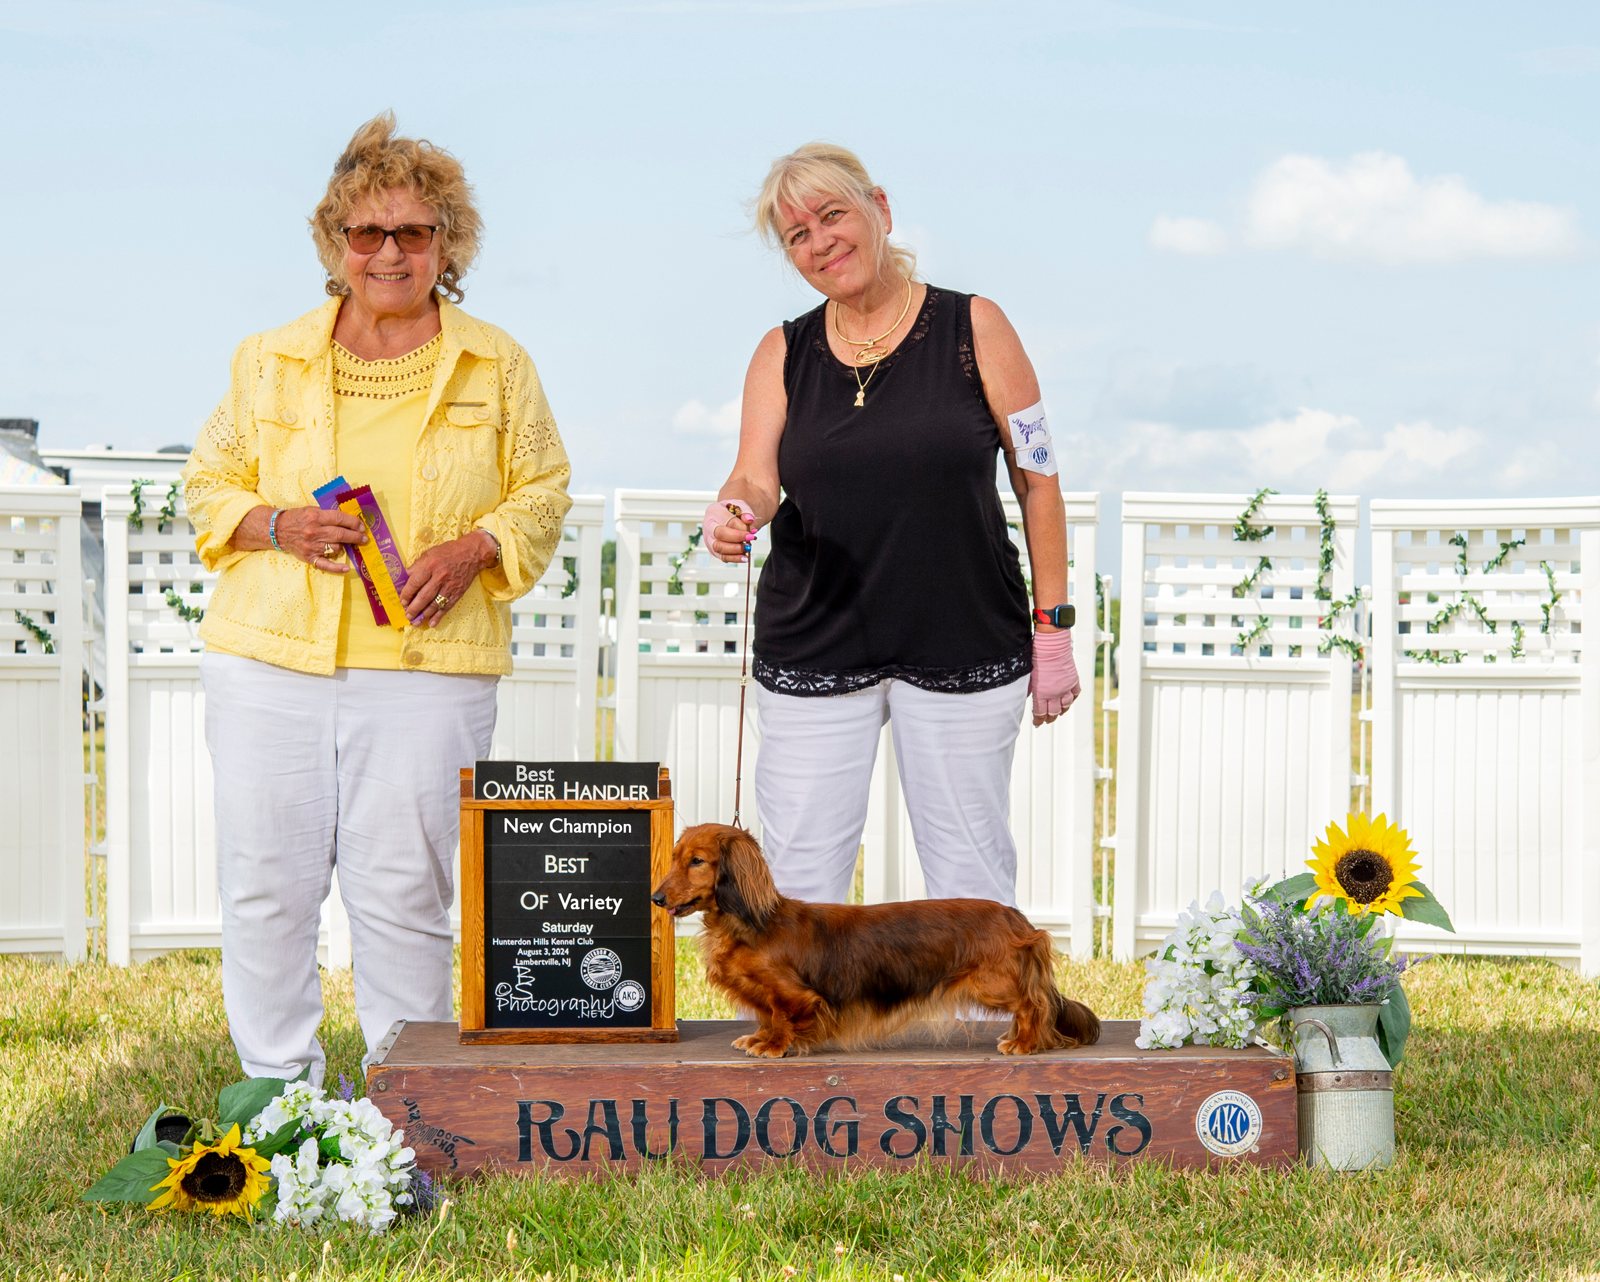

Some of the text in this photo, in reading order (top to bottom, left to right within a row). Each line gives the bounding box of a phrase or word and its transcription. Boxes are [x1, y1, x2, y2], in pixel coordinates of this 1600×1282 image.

[516, 765, 555, 782] Best
[483, 780, 650, 801] OWNER HANDLER
[503, 818, 632, 838] New Champion
[544, 855, 589, 874] BEST
[520, 891, 623, 915] OF Variety
[541, 922, 594, 935] Saturday
[492, 938, 594, 946] Hunterdon Hills Kennel Club
[517, 948, 569, 957] August 3, 2024
[515, 958, 572, 967] Lambertville, NJ
[622, 991, 637, 1001] AKC
[495, 994, 615, 1019] Photography
[1201, 1095, 1257, 1130] AMERICAN KENNEL CLUB
[516, 1094, 1154, 1161] RAU DOG SHOWS
[1211, 1105, 1247, 1143] AKC
